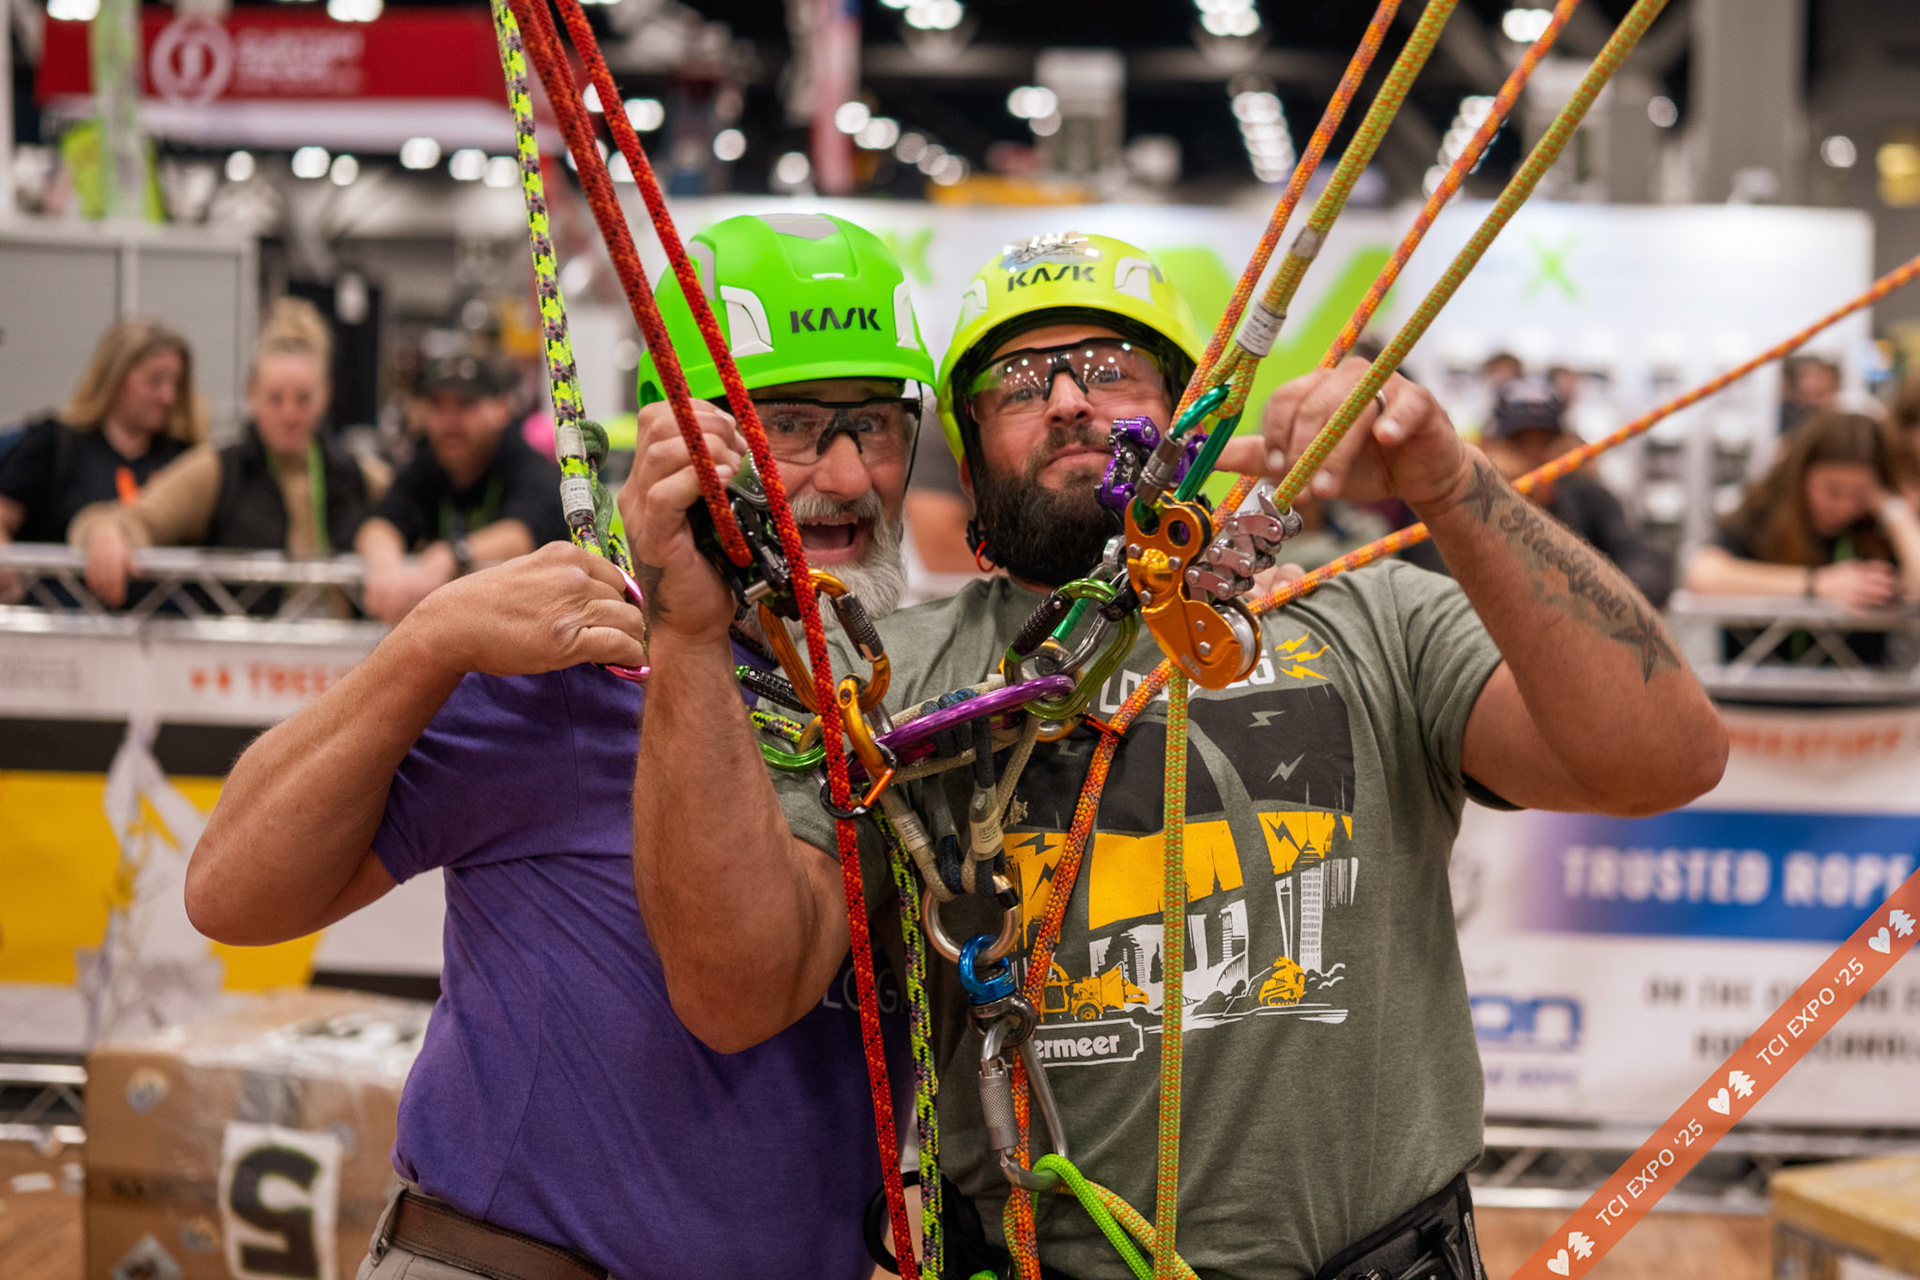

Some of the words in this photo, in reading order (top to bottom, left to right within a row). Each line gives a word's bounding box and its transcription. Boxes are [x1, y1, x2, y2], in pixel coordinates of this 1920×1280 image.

[1007, 265, 1095, 292] KASK
[790, 307, 882, 334] KASK
[1564, 846, 1771, 905] TRUSTED
[1033, 1034, 1120, 1059] ermeer
